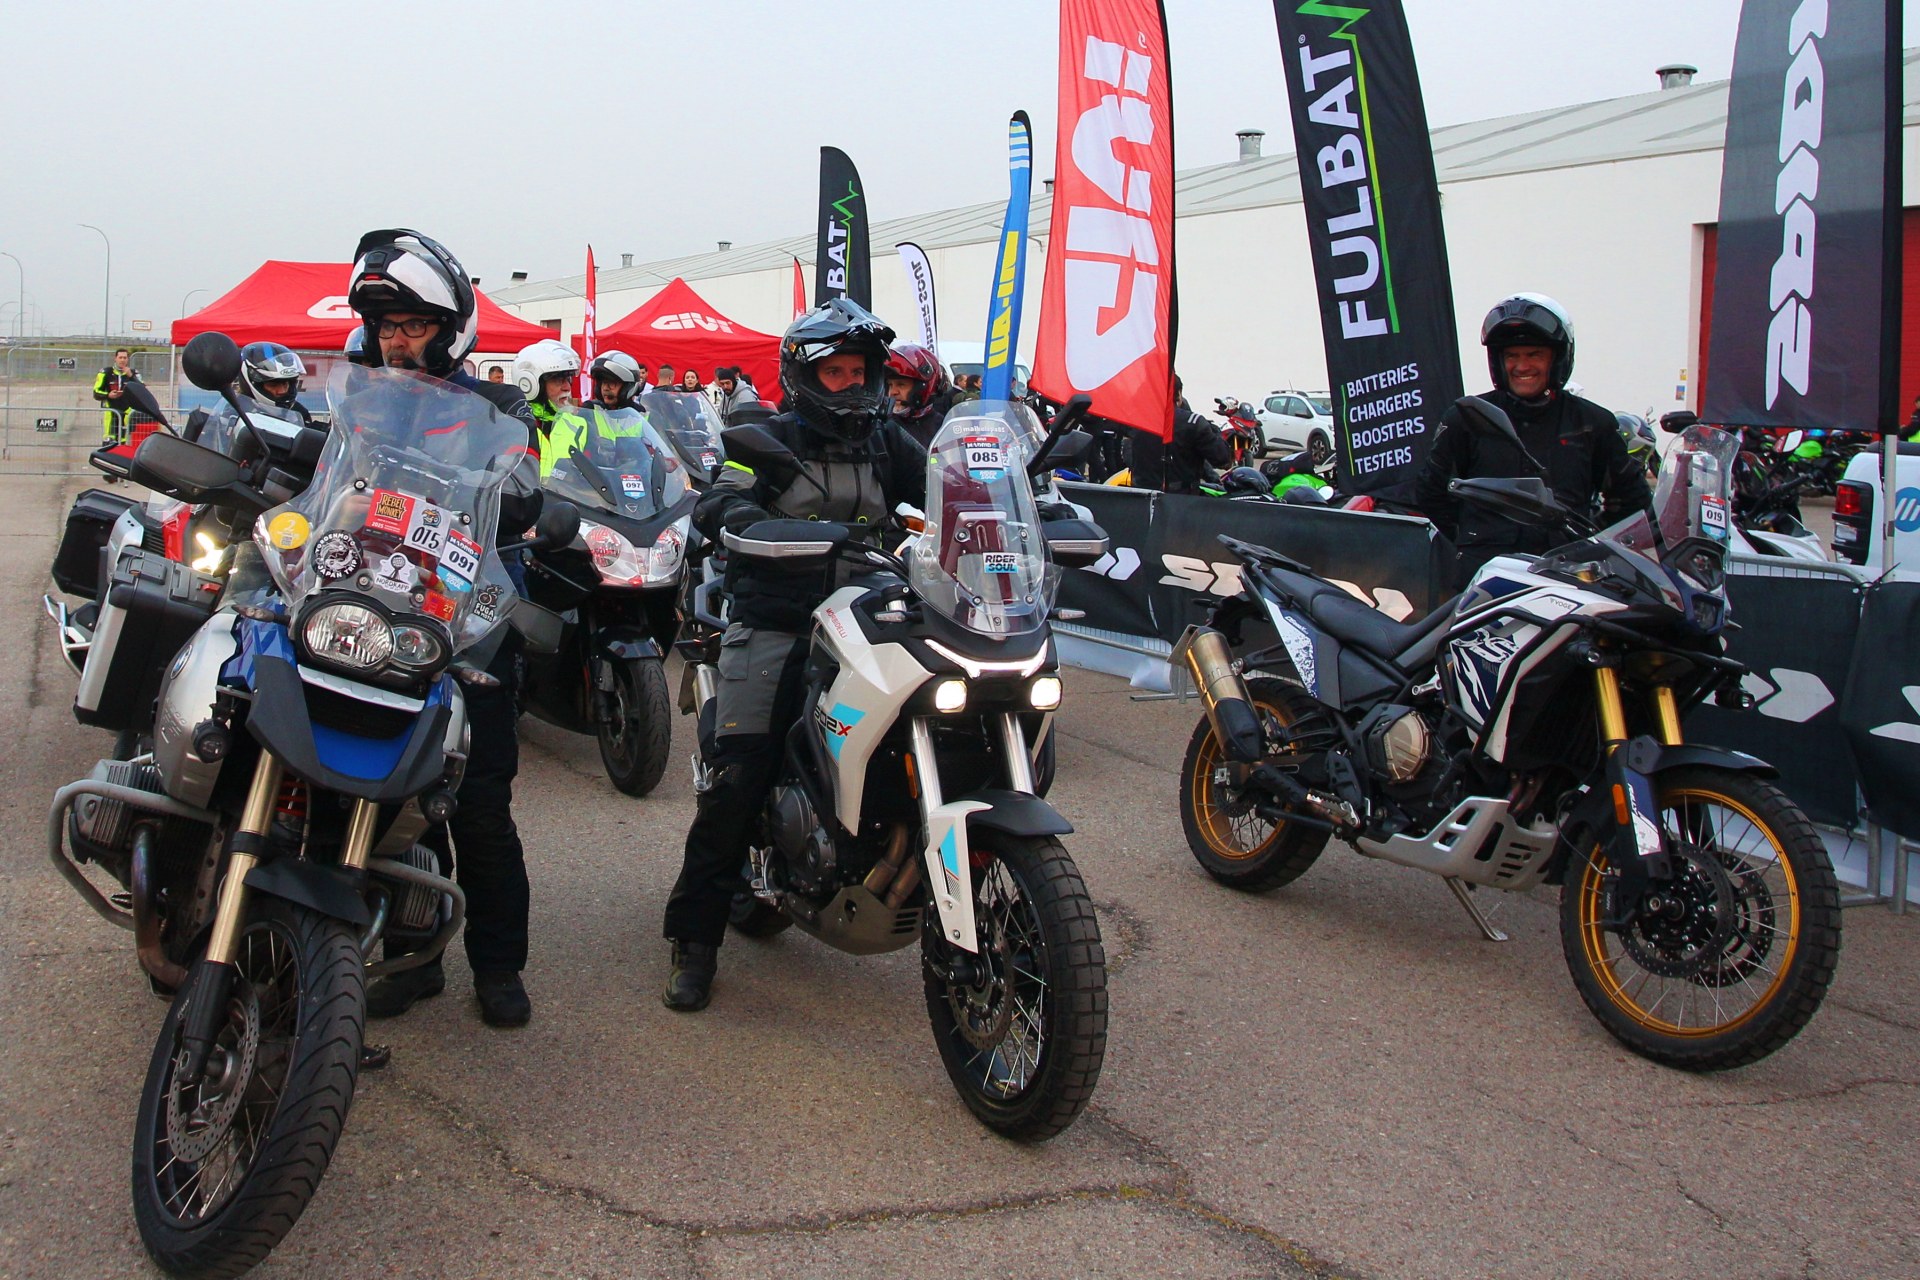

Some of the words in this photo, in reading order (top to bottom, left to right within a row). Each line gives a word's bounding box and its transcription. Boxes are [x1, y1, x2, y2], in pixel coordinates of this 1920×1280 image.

[1299, 45, 1389, 340] FULBAT
[650, 311, 734, 334] GIVI
[1346, 362, 1419, 398] BATTERIES
[1349, 389, 1423, 423] CHARGERS
[39, 419, 55, 427] AMS
[1351, 416, 1426, 449] BOOSTERS
[971, 451, 999, 463] 085
[1354, 446, 1412, 475] TESTERS
[382, 494, 405, 509] REBEL
[377, 504, 403, 519] MONKEY
[1706, 509, 1723, 522] 019
[411, 526, 442, 550] 015
[448, 550, 475, 573] 091
[985, 555, 1016, 563] RIDER
[317, 564, 343, 579] JAPAN
[343, 559, 358, 575] TRIP
[987, 563, 1016, 572] SOUL
[375, 577, 410, 591] NORDKAPP
[443, 604, 453, 613] 27
[475, 602, 494, 615] FUGA
[1554, 600, 1573, 610] VOGE
